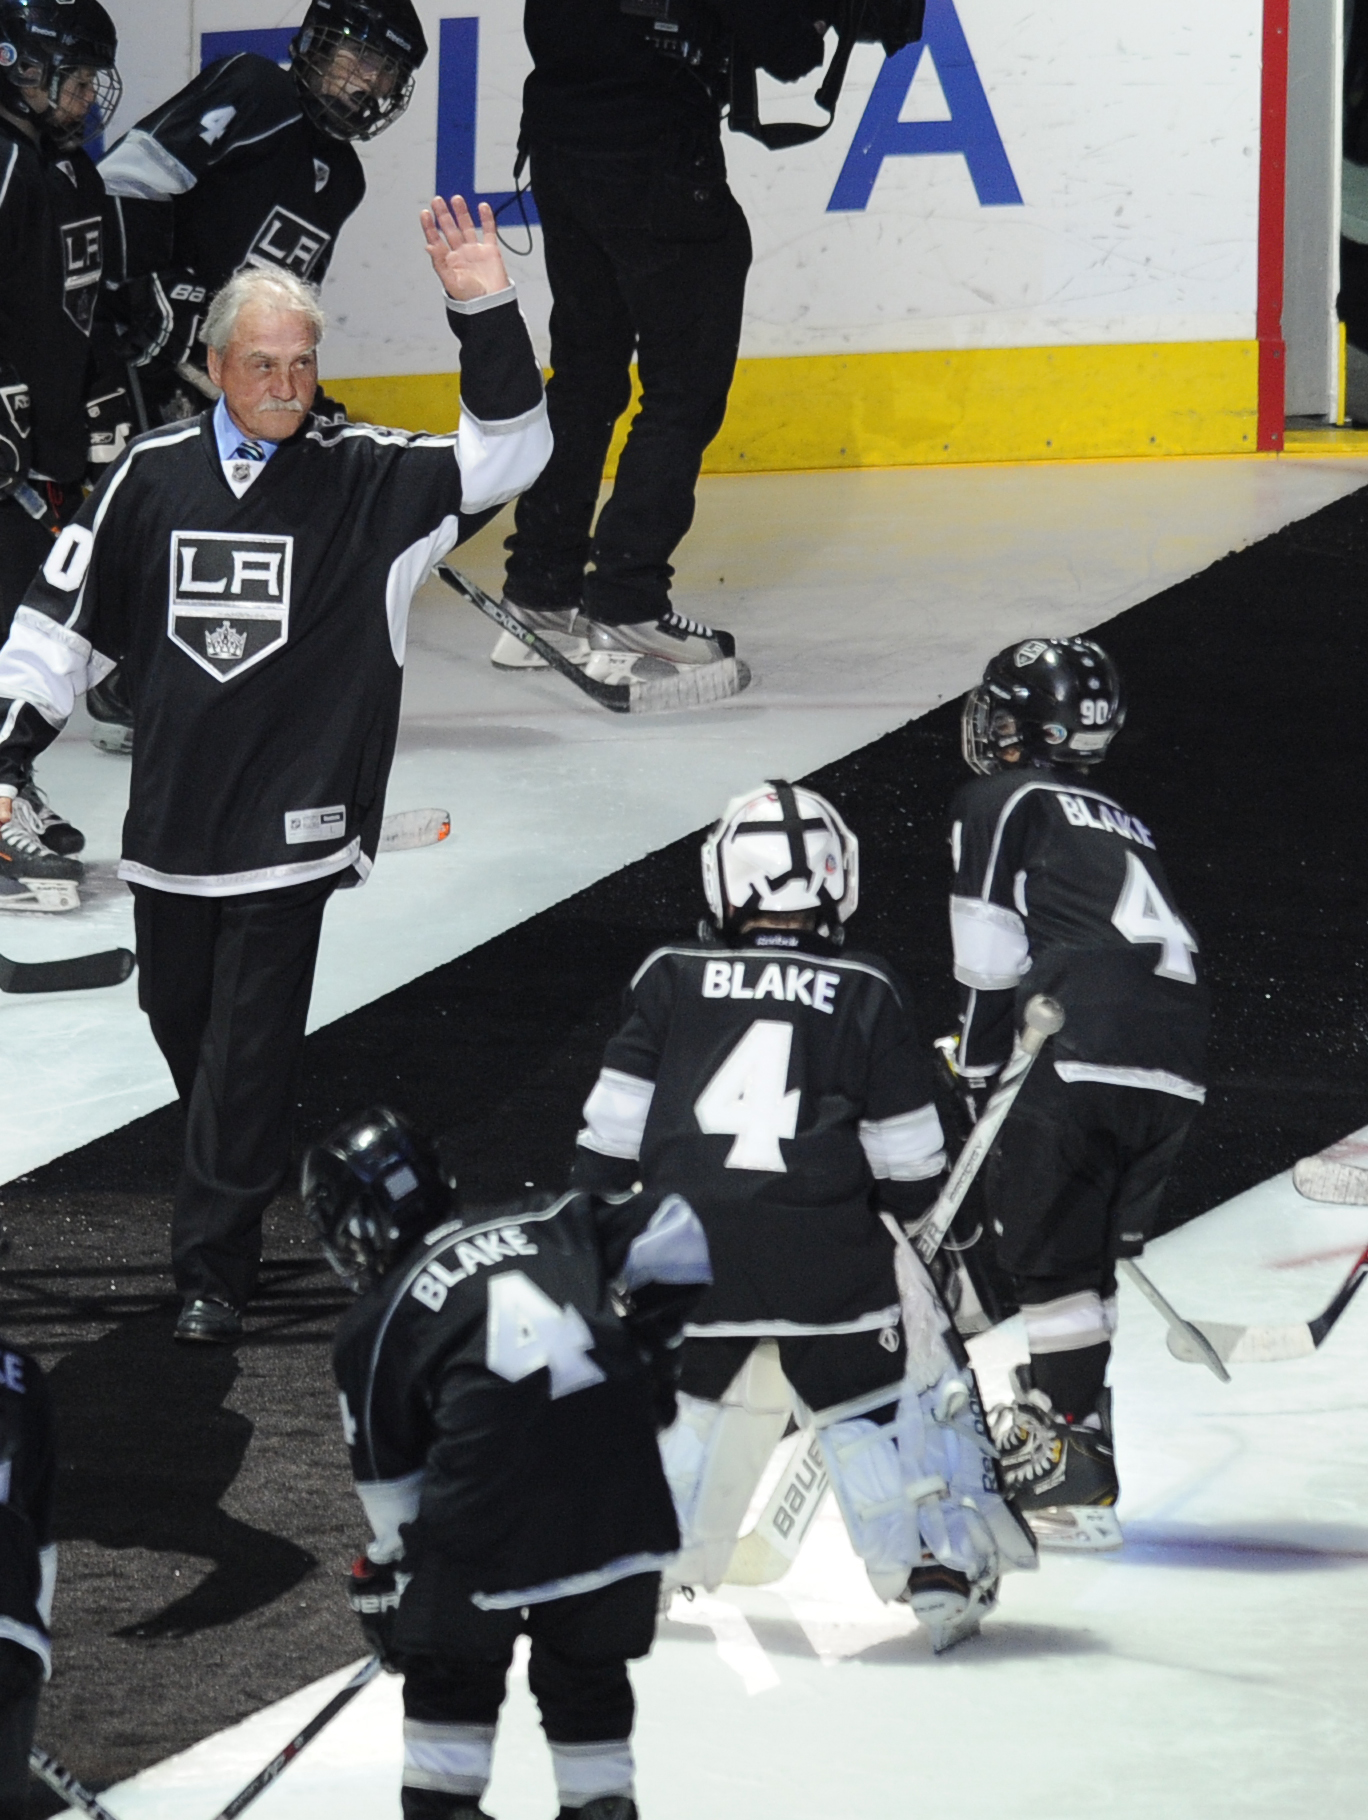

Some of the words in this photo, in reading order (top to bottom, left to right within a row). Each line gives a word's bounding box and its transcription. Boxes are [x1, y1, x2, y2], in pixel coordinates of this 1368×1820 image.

[199, 105, 237, 146] 4
[66, 230, 99, 270] LA
[259, 219, 320, 272] LA
[179, 547, 282, 596] LA
[1080, 698, 1109, 726] 90
[1055, 793, 1157, 851] BLAKE
[1111, 850, 1199, 985] 4
[702, 960, 841, 1015] BLAKE
[694, 1019, 802, 1173] 4
[411, 1226, 538, 1313] BLAKE
[487, 1269, 607, 1400] 4
[773, 1438, 823, 1540] BAUE
